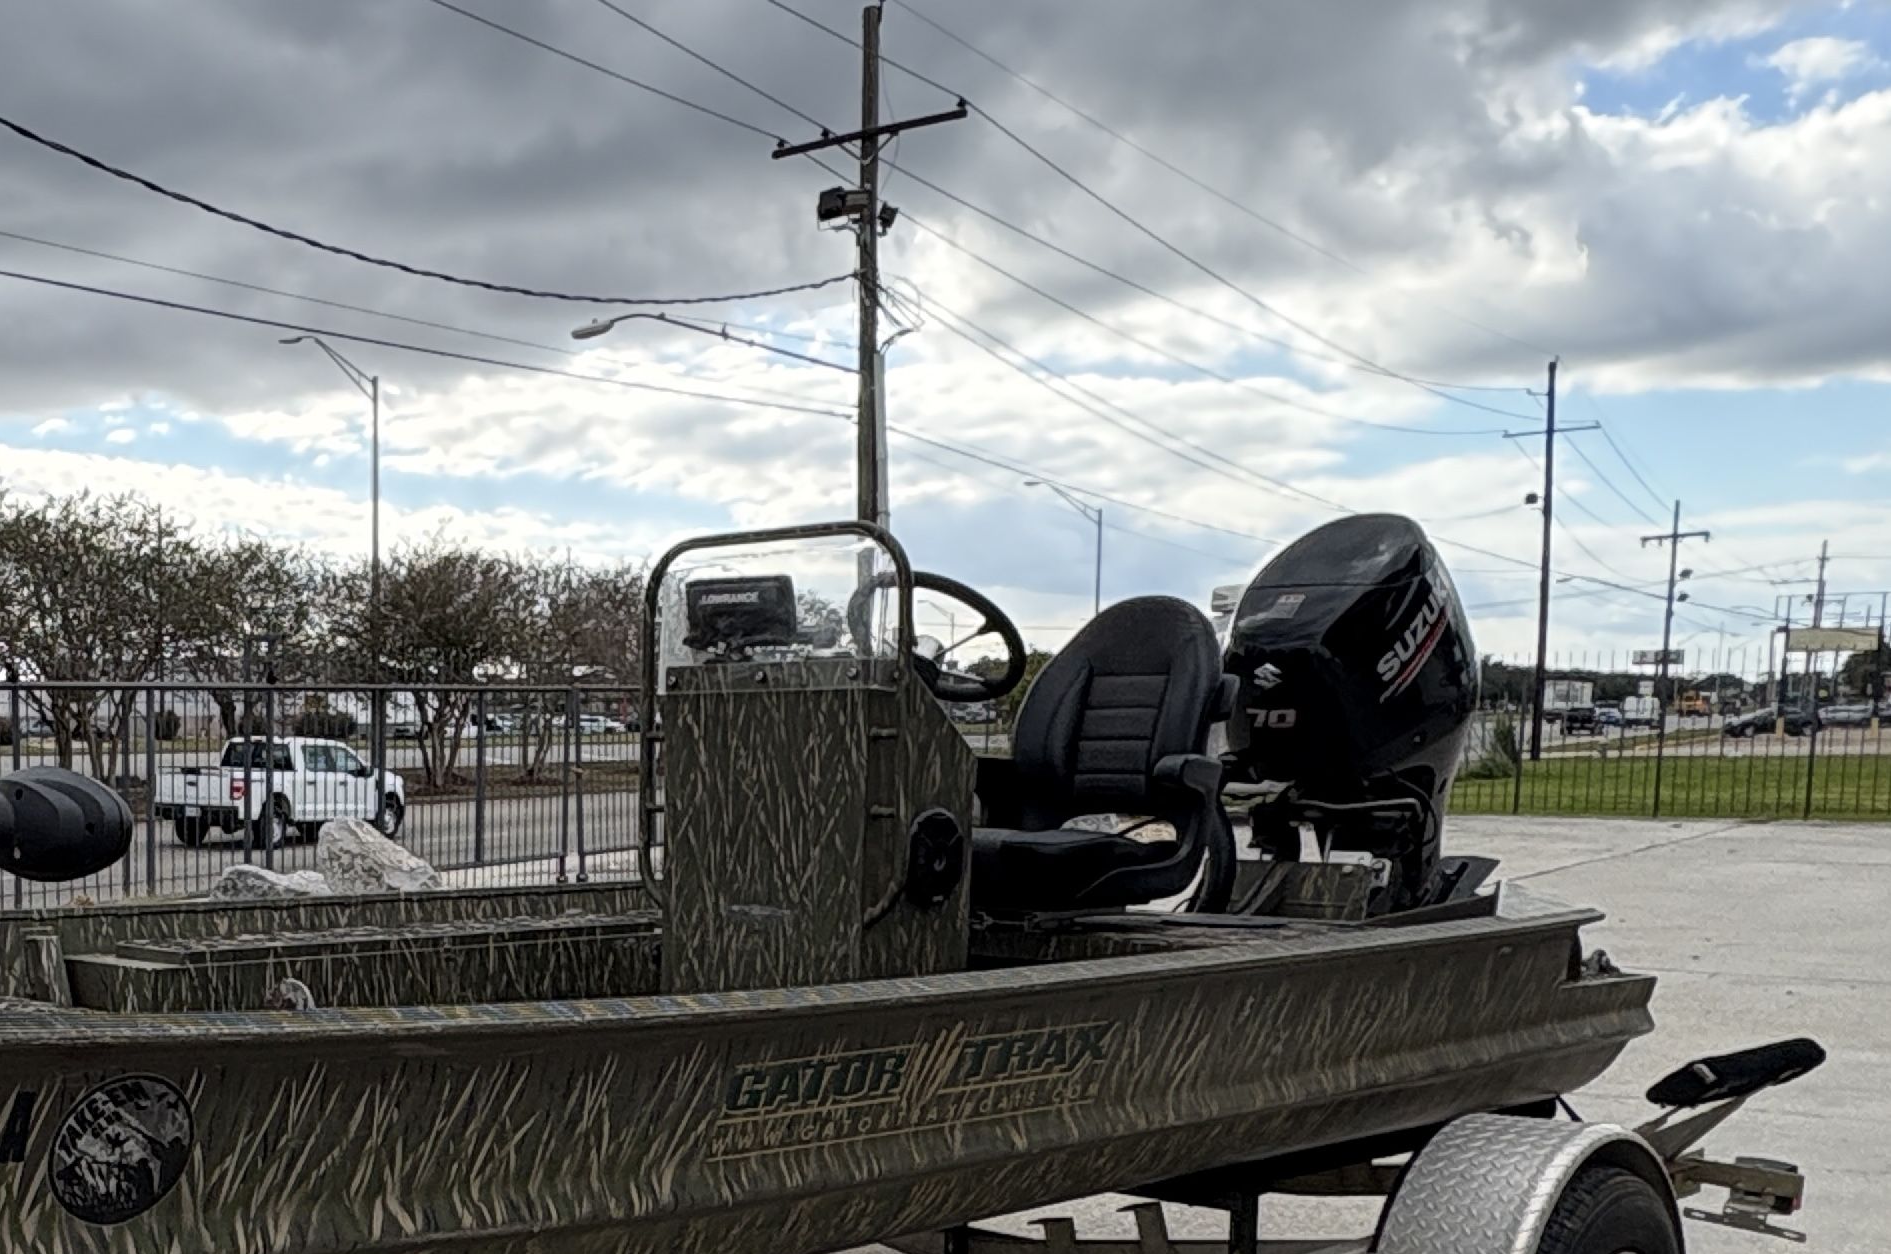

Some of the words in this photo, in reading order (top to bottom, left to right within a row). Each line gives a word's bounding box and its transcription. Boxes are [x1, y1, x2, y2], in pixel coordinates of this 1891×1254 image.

[1246, 709, 1297, 729] 70
[724, 1053, 913, 1118] GATOR
[953, 1027, 1116, 1082] TRAX
